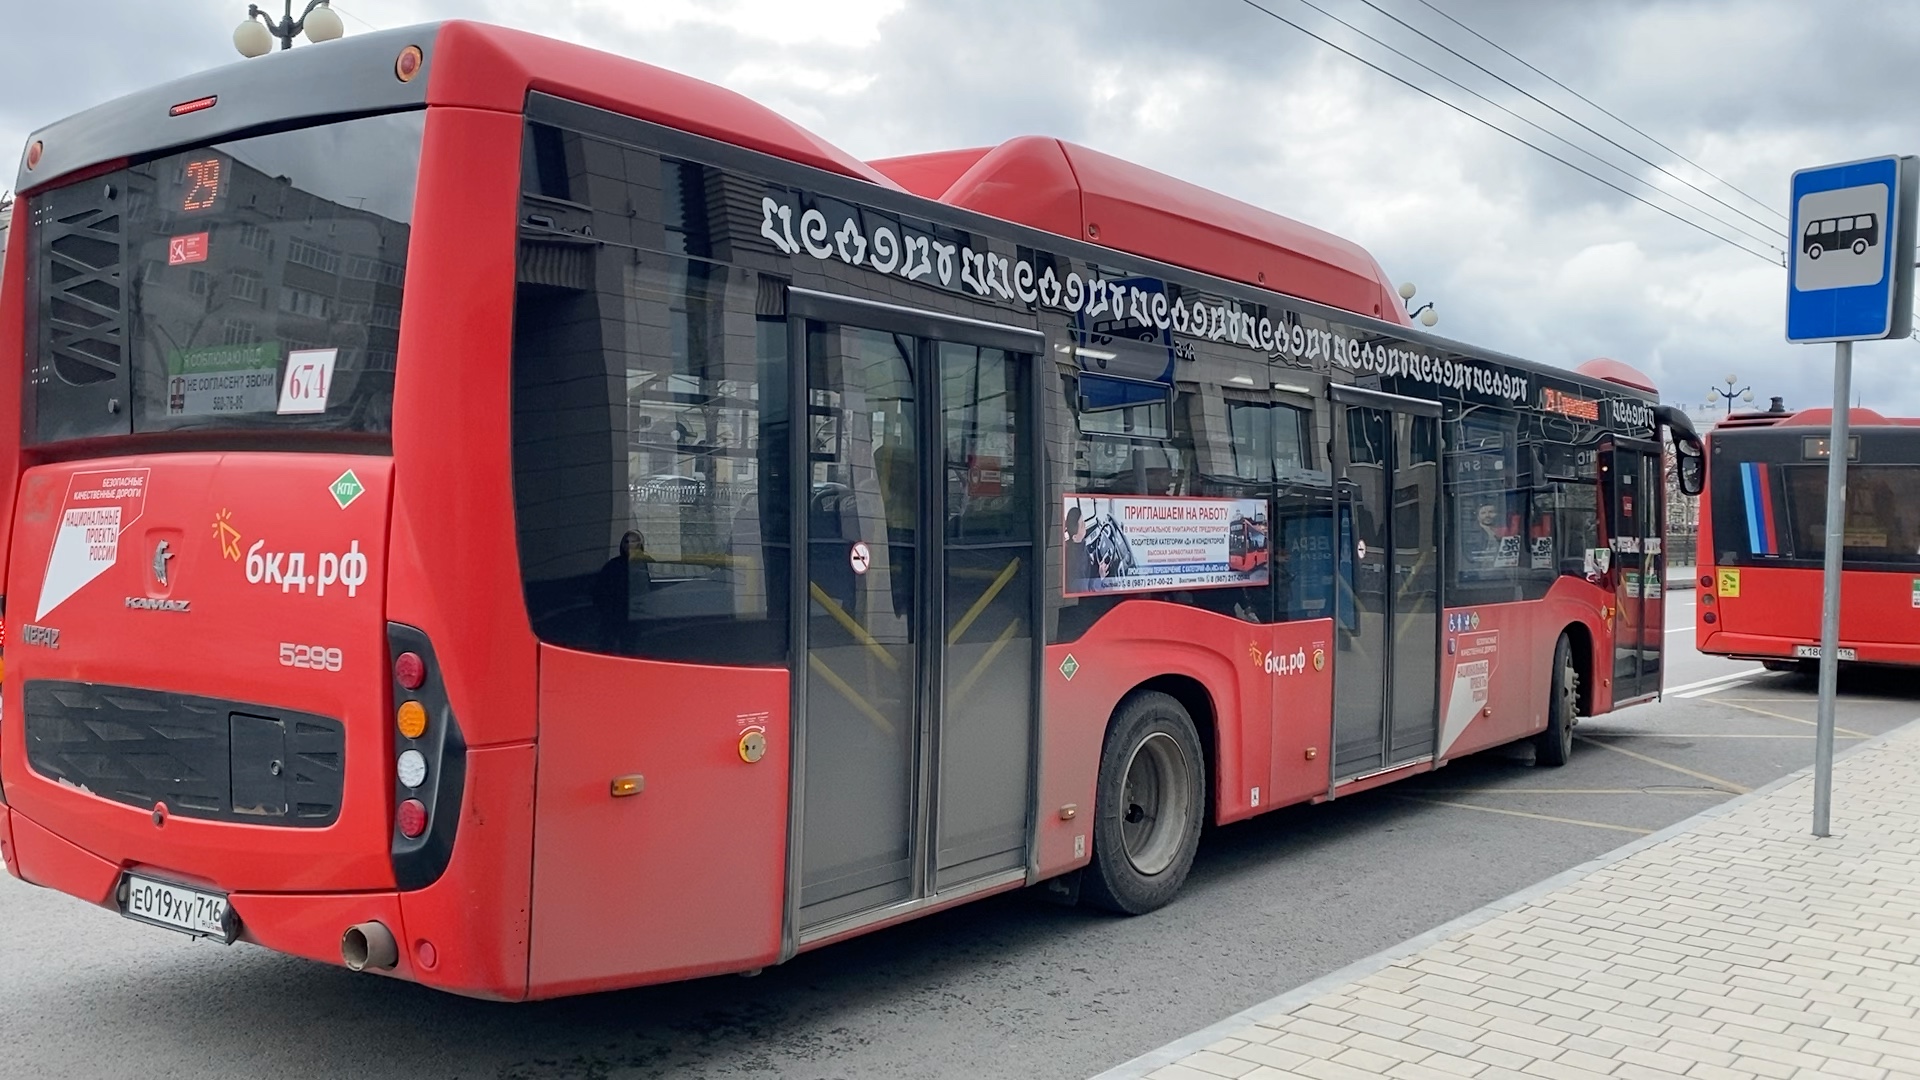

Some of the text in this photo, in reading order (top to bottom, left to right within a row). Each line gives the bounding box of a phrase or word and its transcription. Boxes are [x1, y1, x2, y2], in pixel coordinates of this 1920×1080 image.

[184, 160, 219, 210] 29
[192, 350, 240, 367] СОБЛЮДАЮ
[186, 373, 274, 392] НЕ СОГЛАСЕН? ЗВОНИ
[290, 364, 326, 400] 674
[102, 476, 144, 488] БЕЗОПАСНЫЕ
[336, 482, 357, 496] КПГ
[74, 488, 141, 500] КАЧЕСТВЕННЫЕ ДОРОГИ
[66, 509, 120, 528] НАЦИОНАЛЬНЫЕ
[1124, 506, 1228, 520] ПРИГЛАШАЕМ НА РАБОТУ
[86, 528, 117, 543] ПРОЕКТЫ
[89, 545, 115, 561] РОССИИ
[245, 539, 368, 598] бкд.рф
[125, 596, 191, 612] KAMAZ
[22, 624, 60, 649] NEFAZ
[279, 642, 342, 672] 5299
[1264, 646, 1306, 676] бкд.рф
[197, 897, 222, 922] 716
[202, 920, 214, 930] RUS
